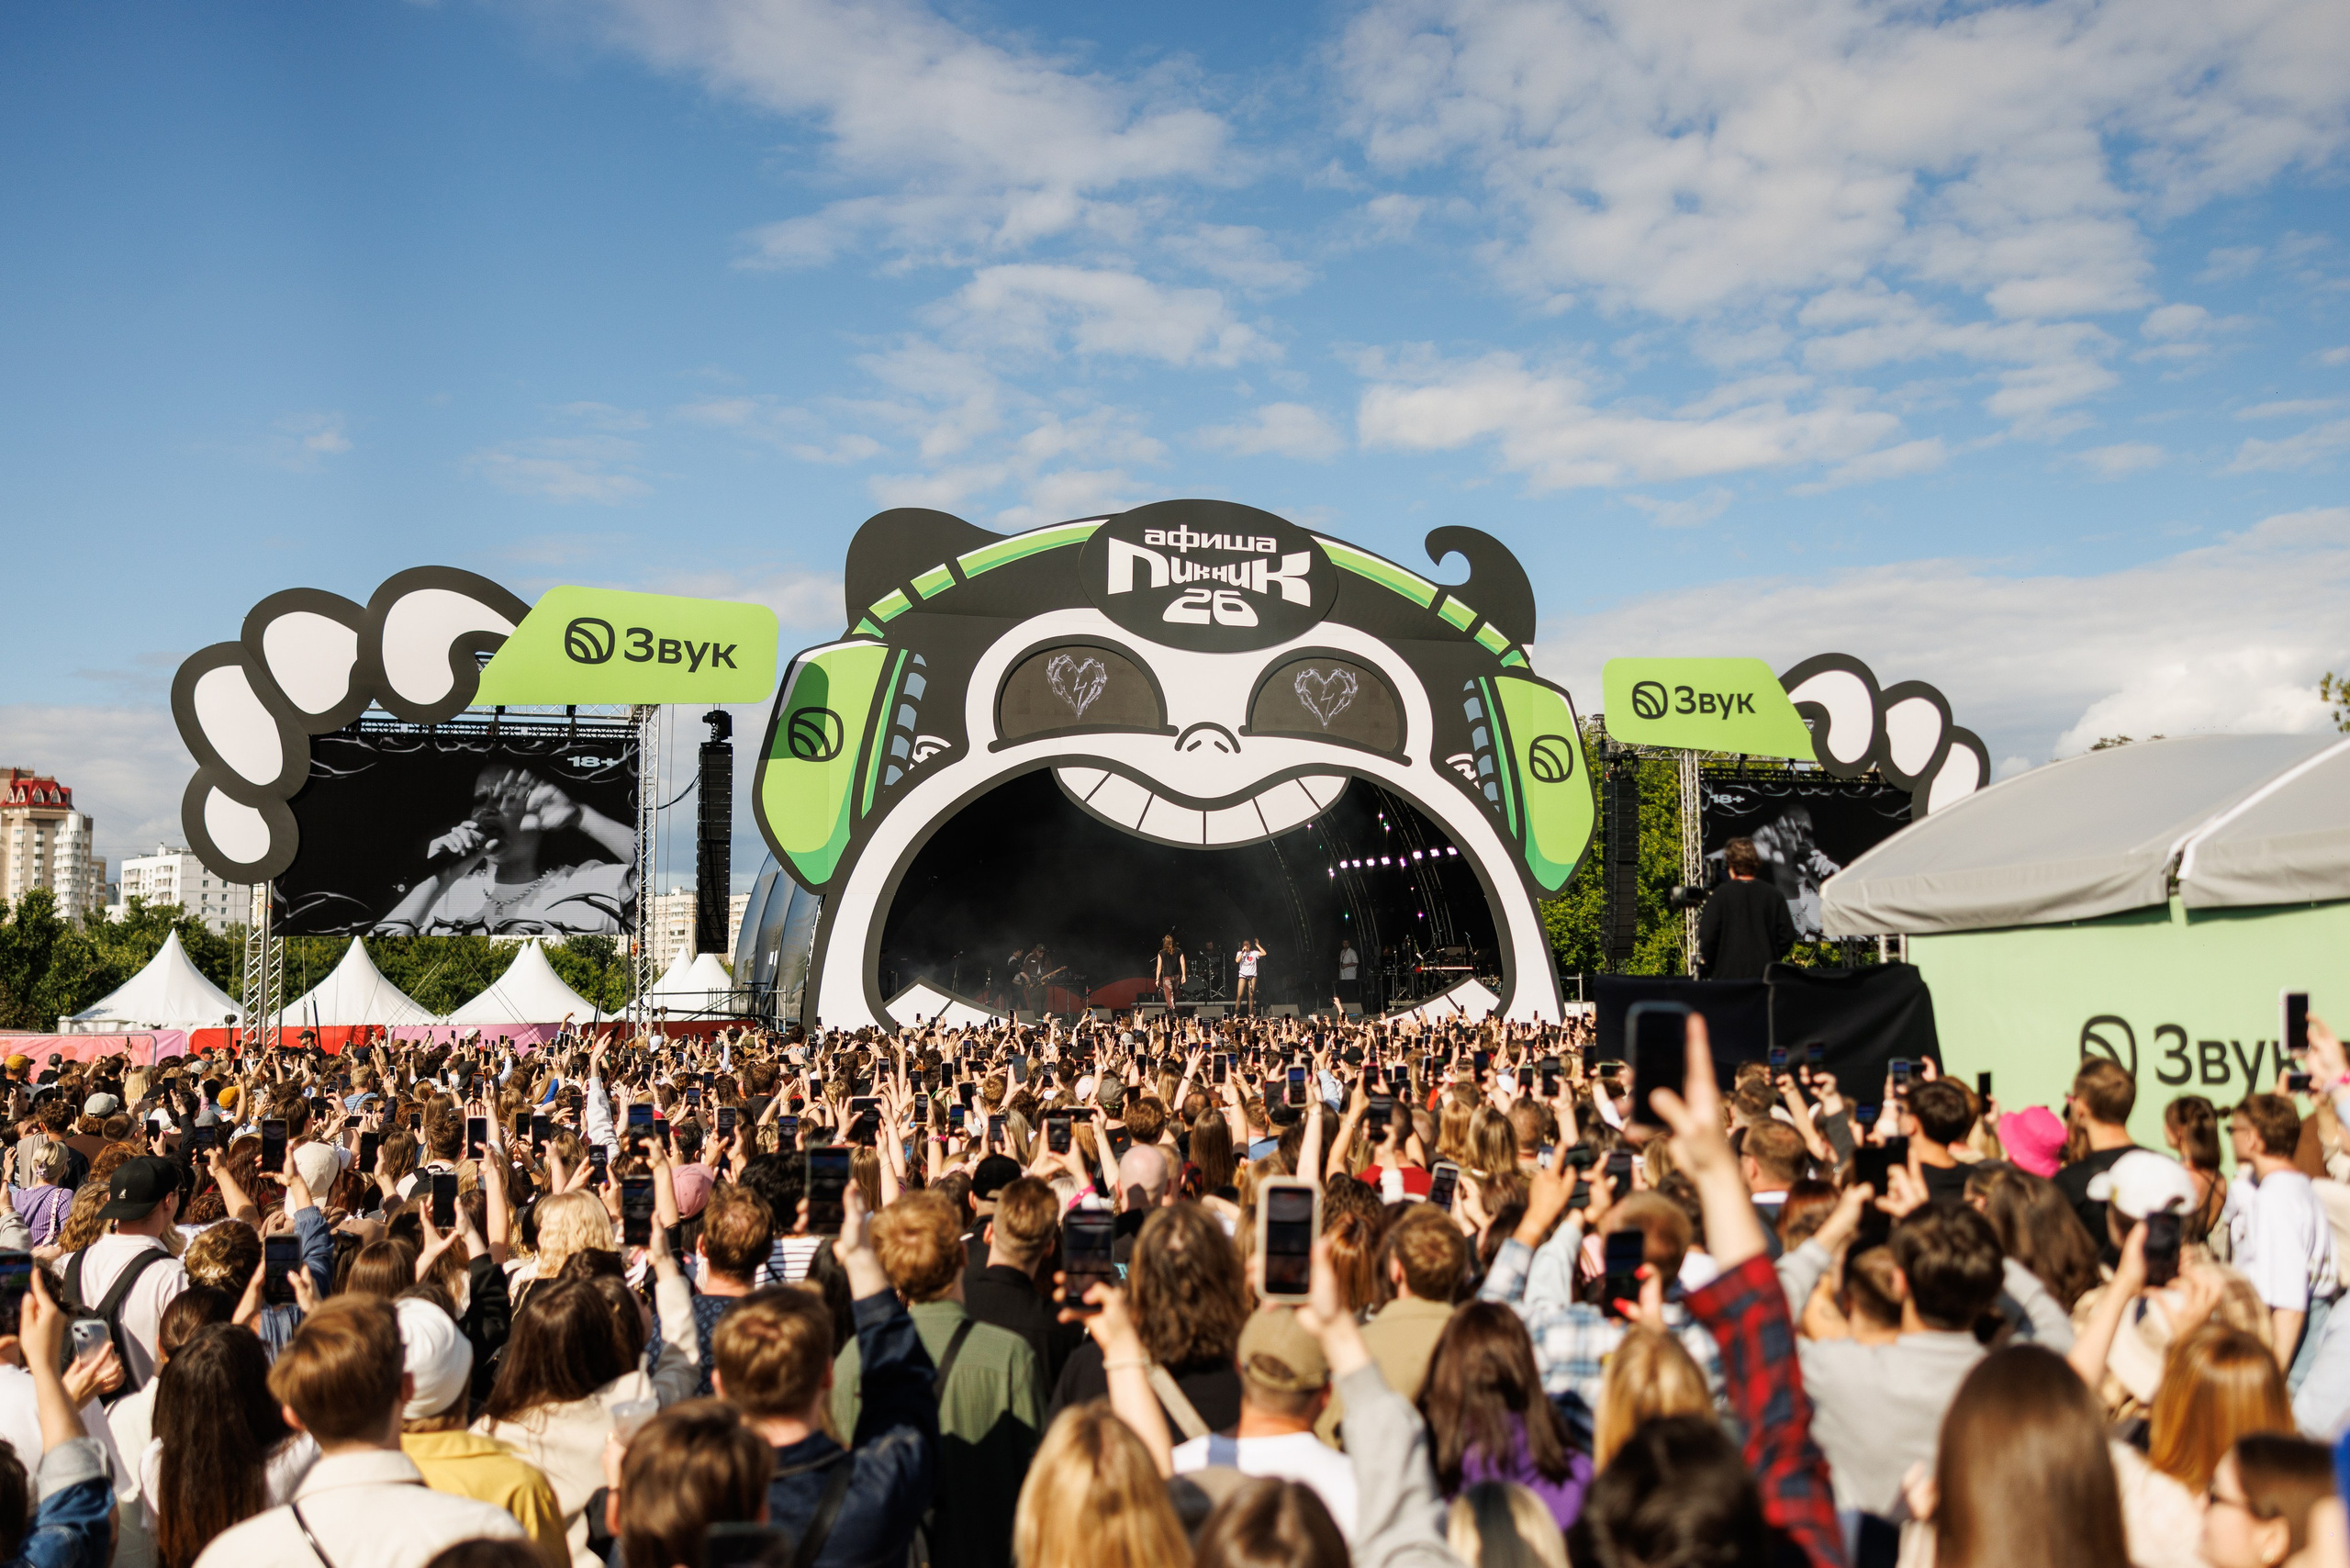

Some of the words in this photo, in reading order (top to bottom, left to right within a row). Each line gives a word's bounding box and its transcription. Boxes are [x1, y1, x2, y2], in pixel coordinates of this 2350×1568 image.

[1144, 524, 1277, 554] афиша
[1161, 588, 1259, 628] 26
[623, 627, 738, 673] Звук
[1674, 685, 1756, 721] Звук
[566, 756, 620, 767] 18+
[1709, 793, 1745, 804] 18+
